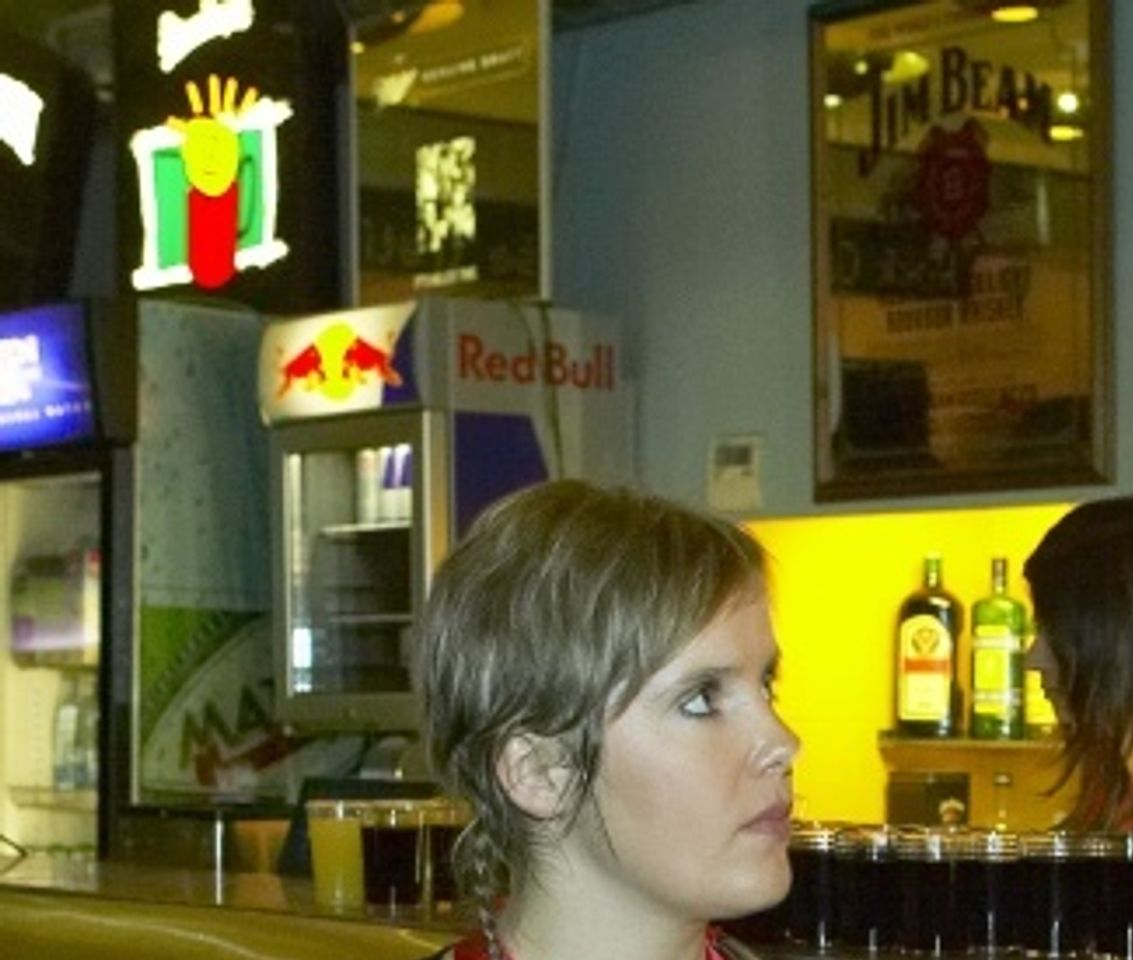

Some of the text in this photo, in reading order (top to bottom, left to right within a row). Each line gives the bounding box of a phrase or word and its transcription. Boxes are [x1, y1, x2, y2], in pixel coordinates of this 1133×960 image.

[858, 46, 1055, 178] JIM BEAM
[458, 333, 616, 392] Red Bull
